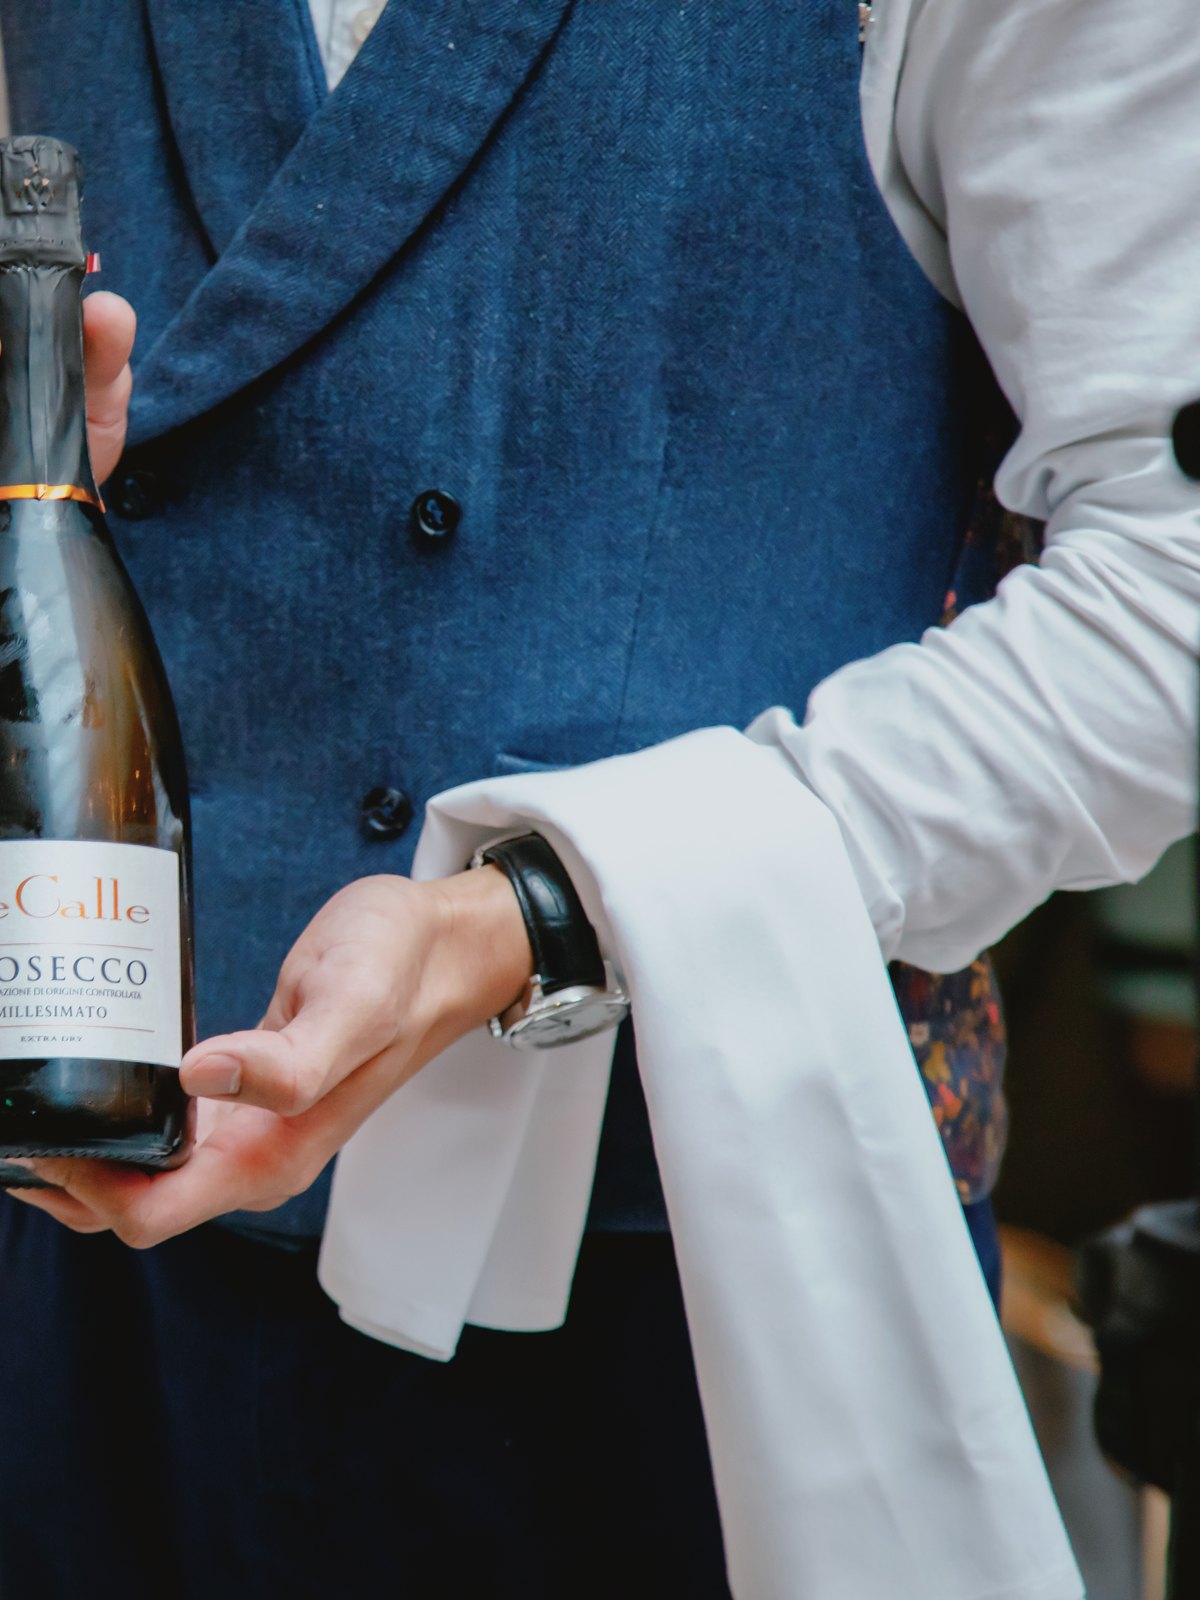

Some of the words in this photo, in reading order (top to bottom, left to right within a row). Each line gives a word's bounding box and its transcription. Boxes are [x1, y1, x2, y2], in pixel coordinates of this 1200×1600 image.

[15, 873, 151, 925] Calle
[33, 987, 44, 996] DI
[45, 986, 84, 997] ORIGINE
[85, 987, 143, 1000] CONTROLLATA
[19, 1034, 58, 1043] EXTRA
[60, 1034, 83, 1043] DRY
